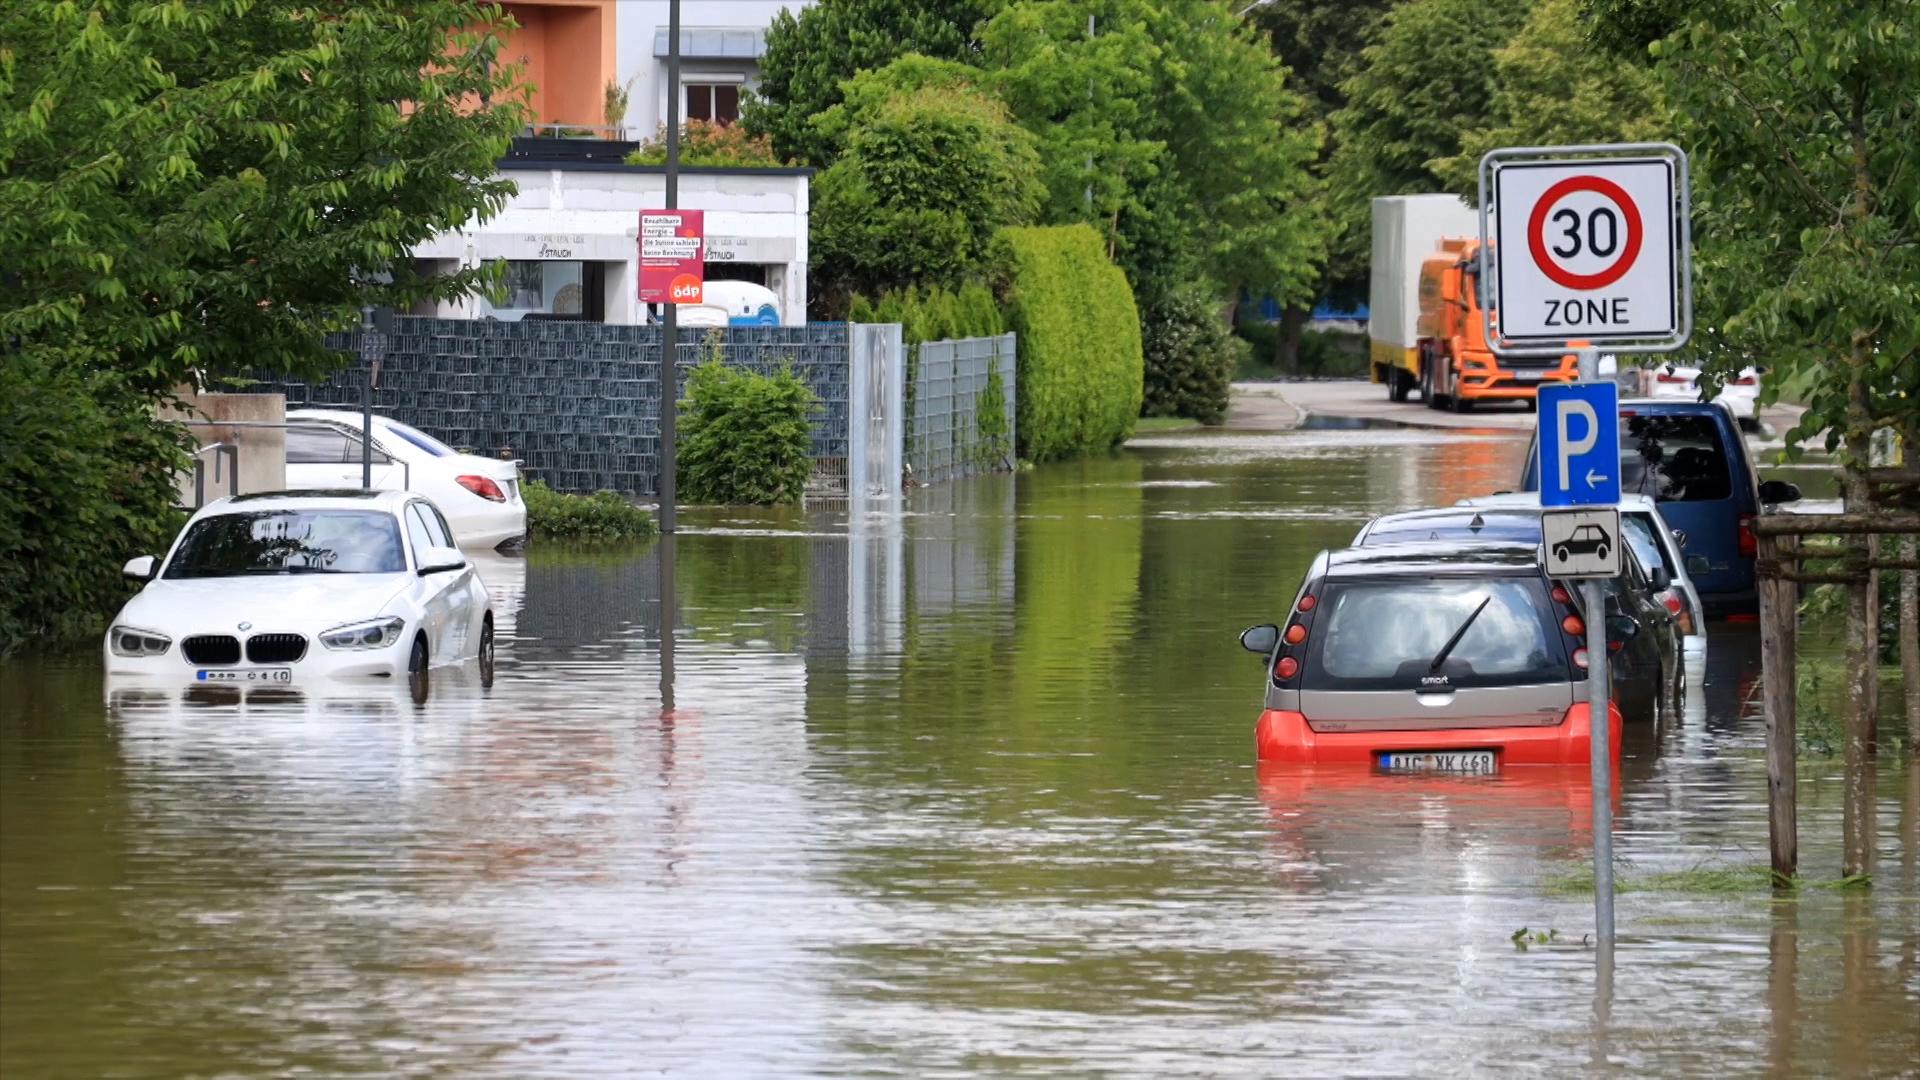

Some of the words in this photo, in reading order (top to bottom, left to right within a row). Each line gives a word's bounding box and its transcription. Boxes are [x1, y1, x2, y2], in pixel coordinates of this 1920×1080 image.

[644, 229, 667, 237] Energie
[1552, 207, 1618, 259] 30
[673, 284, 700, 298] ödp
[1544, 297, 1630, 326] ZONE
[1557, 399, 1598, 491] P
[1421, 675, 1449, 685] smart
